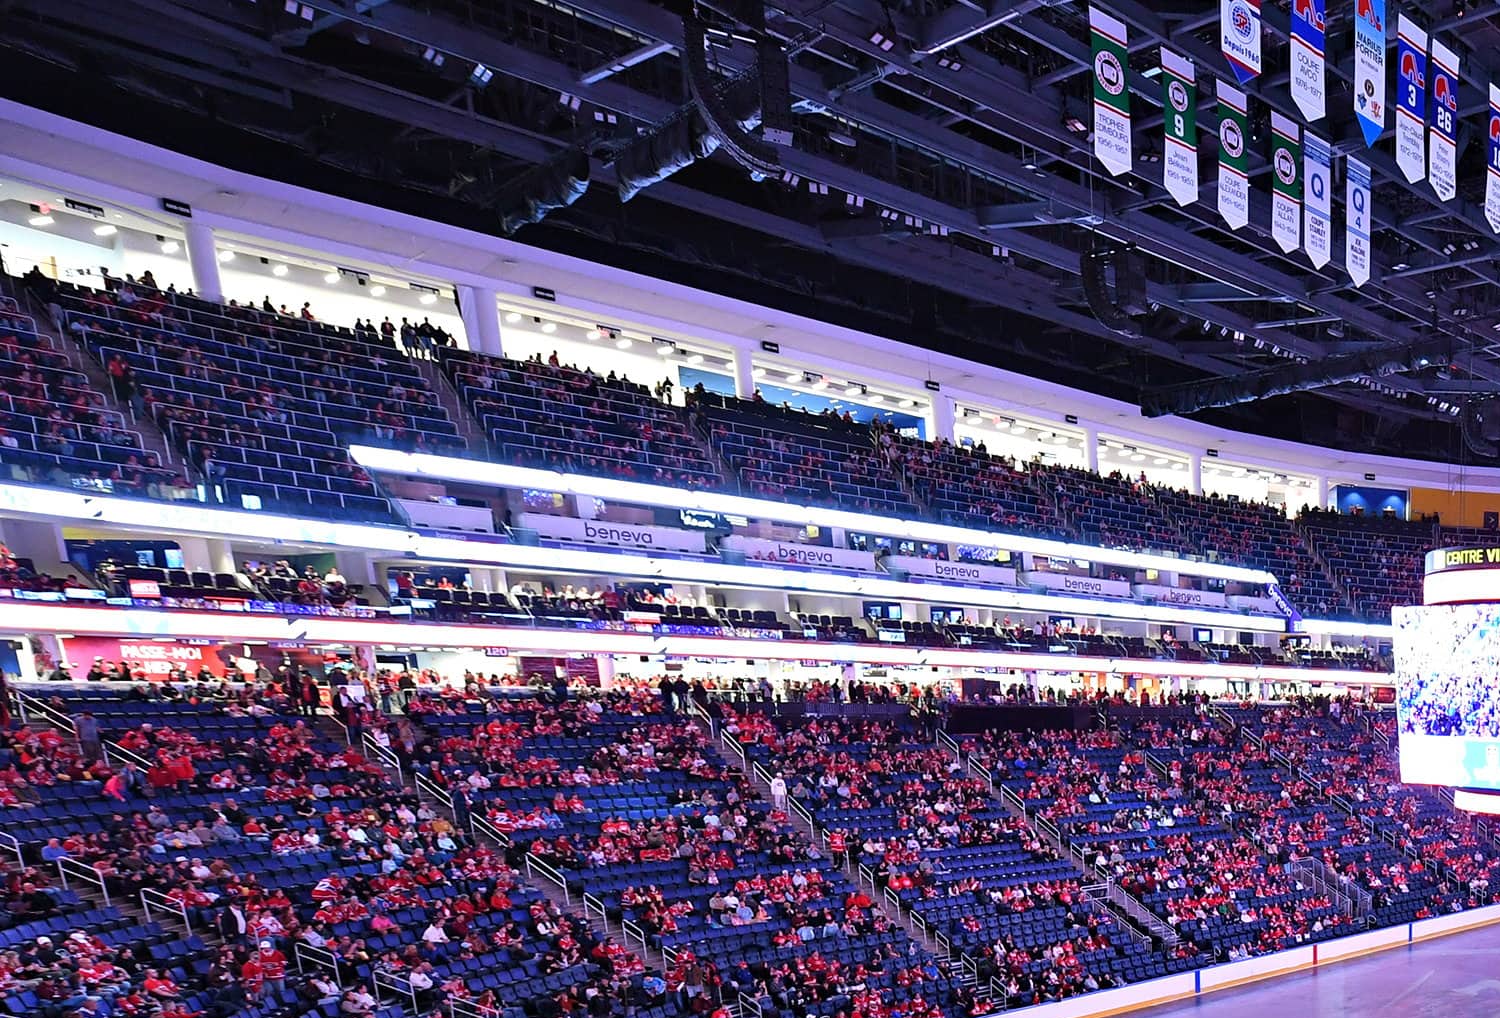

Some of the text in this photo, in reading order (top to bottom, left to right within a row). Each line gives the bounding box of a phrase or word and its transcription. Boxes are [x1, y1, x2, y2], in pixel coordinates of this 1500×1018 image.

[1224, 35, 1245, 55] Depuis
[1355, 42, 1384, 67] FORTIER
[1356, 31, 1383, 56] MARIUS
[1296, 51, 1321, 74] COUPE
[1407, 84, 1416, 108] 3
[1174, 114, 1185, 138] 9
[1437, 106, 1452, 133] 26
[1311, 173, 1325, 201] Q
[1352, 187, 1365, 215] Q
[1355, 216, 1362, 229] 4
[584, 521, 653, 546] beneva
[778, 544, 833, 563] beneva
[1446, 549, 1484, 566] CENTRE
[935, 562, 980, 580] beneva
[1064, 576, 1102, 593] beneva
[1169, 589, 1202, 603] beneva
[1267, 584, 1294, 619] beneva
[485, 646, 508, 657] 120
